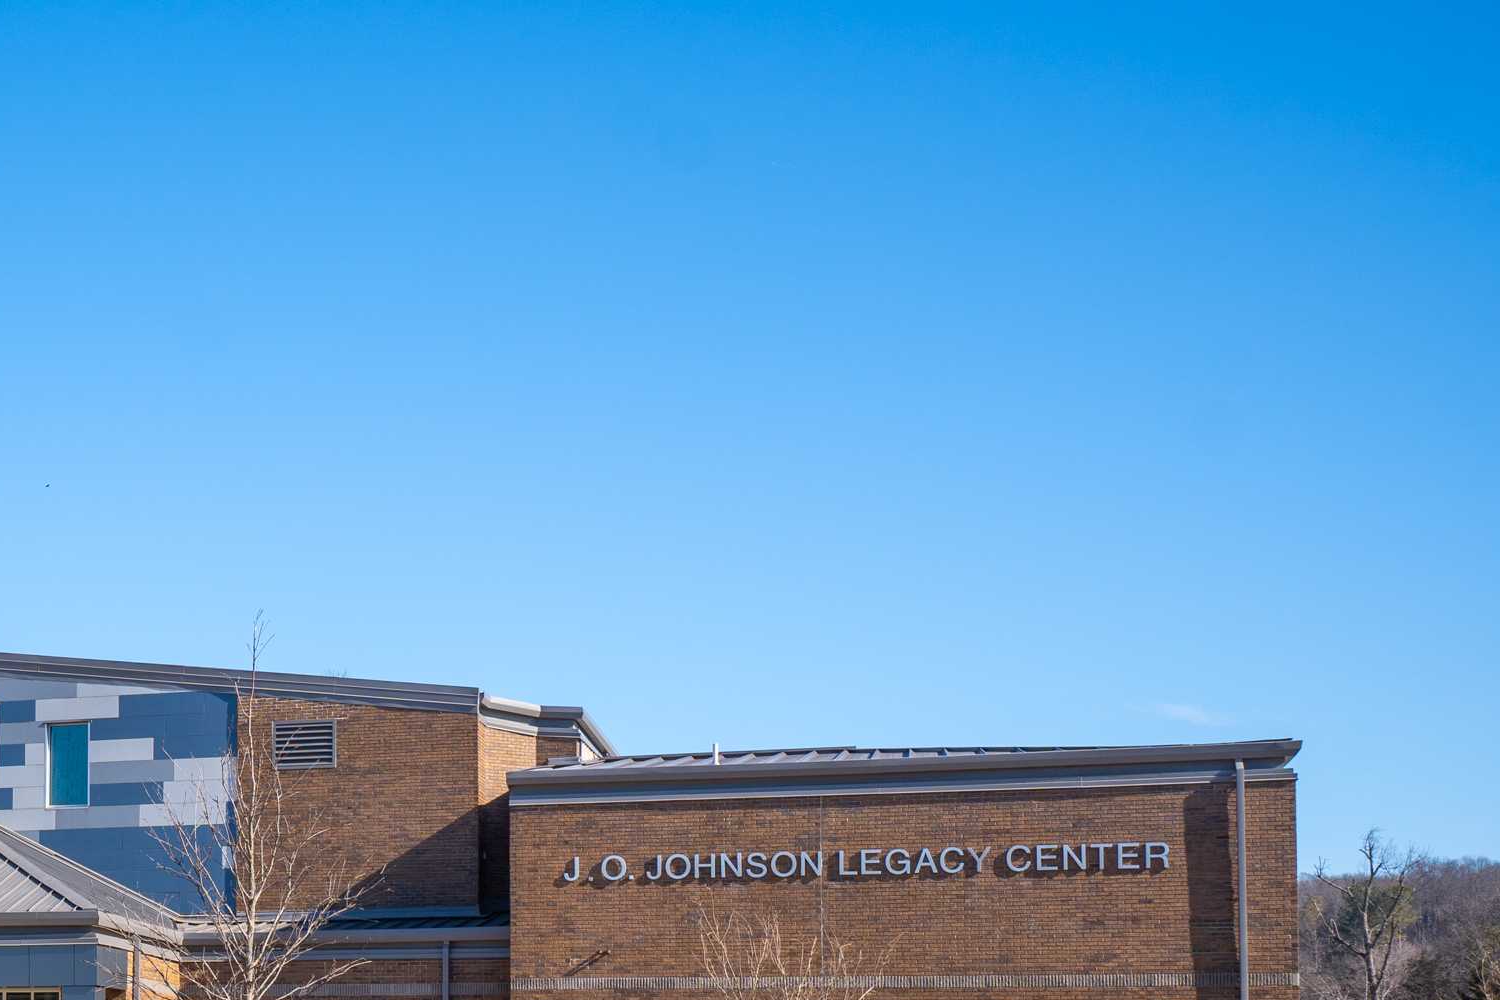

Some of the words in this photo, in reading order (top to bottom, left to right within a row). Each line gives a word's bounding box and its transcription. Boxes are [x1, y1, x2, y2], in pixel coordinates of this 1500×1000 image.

[646, 850, 822, 880] JOHNSON
[838, 846, 992, 876] LEGACY
[1006, 841, 1170, 872] CENTER
